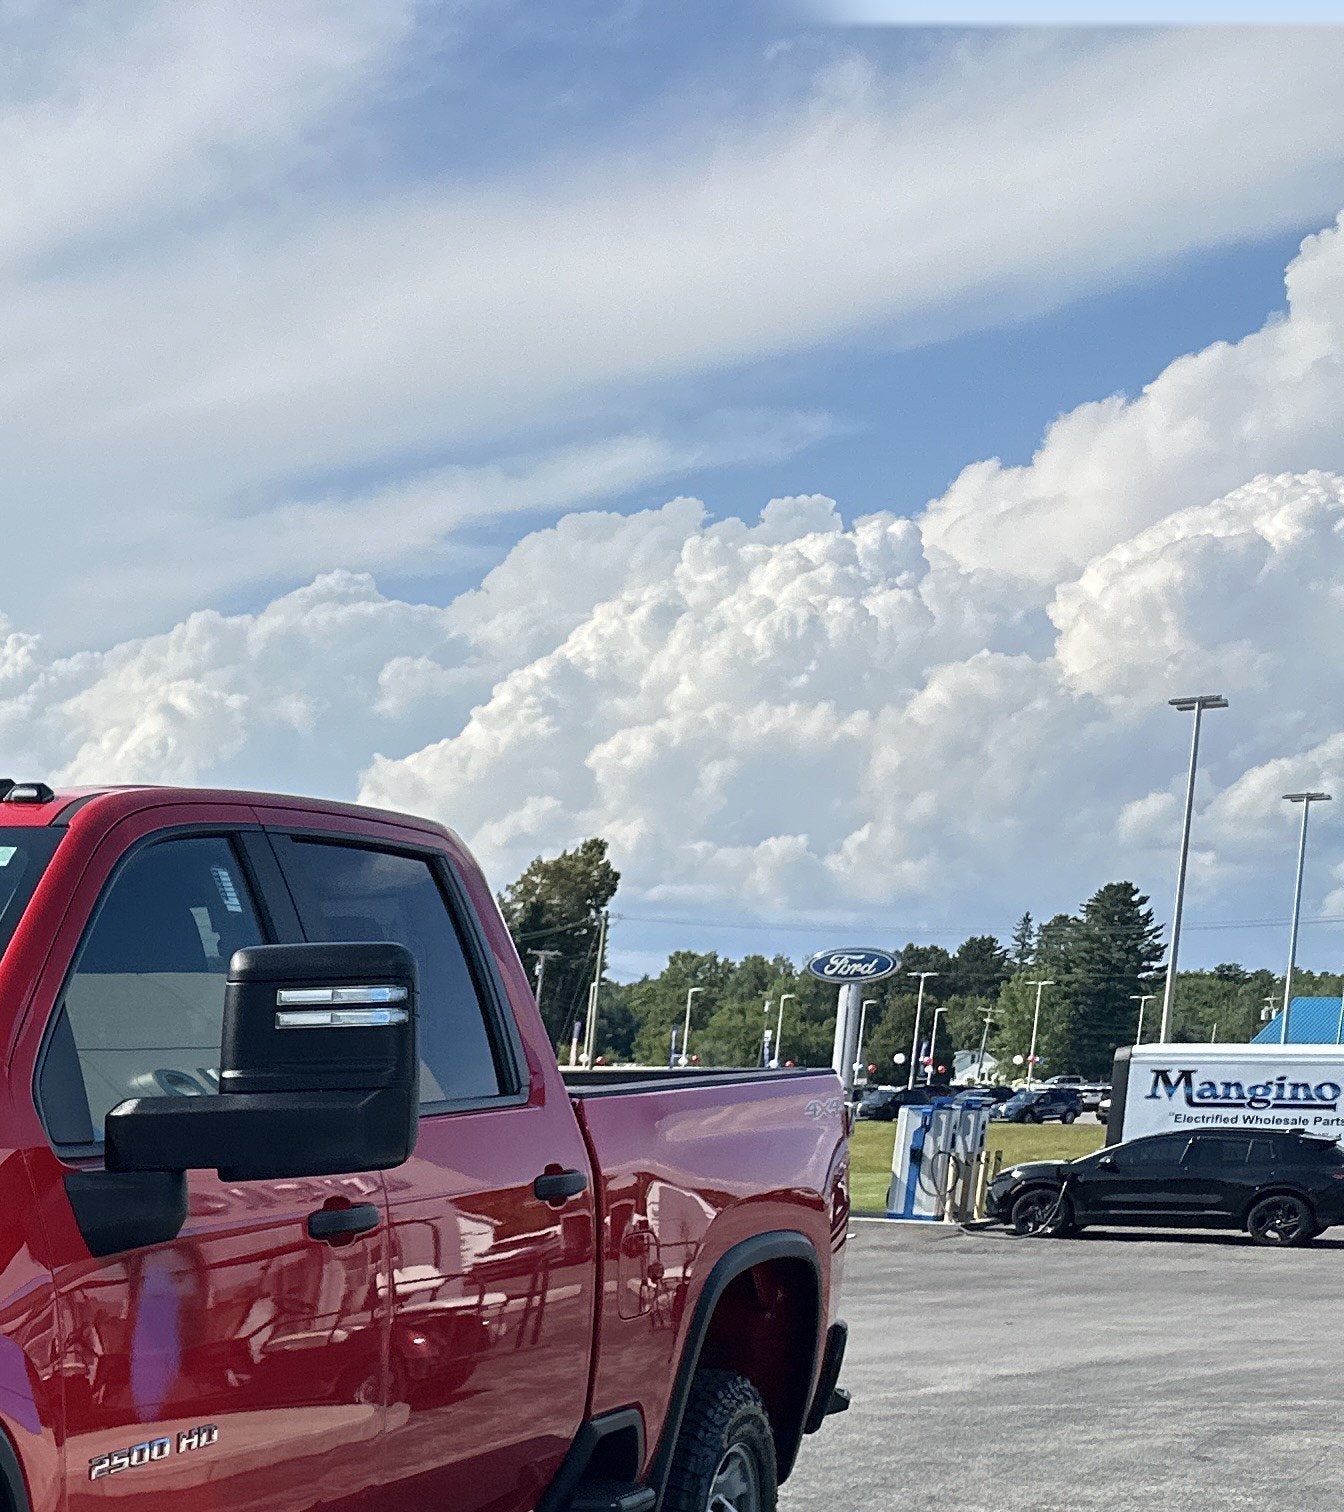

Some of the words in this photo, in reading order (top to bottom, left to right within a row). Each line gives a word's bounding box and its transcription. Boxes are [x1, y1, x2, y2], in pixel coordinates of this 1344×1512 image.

[823, 954, 879, 976] Ford
[1145, 1069, 1341, 1110] Mangino
[1242, 1114, 1310, 1126] Wholesale
[88, 1437, 171, 1481] 2500
[176, 1423, 219, 1454] HD
